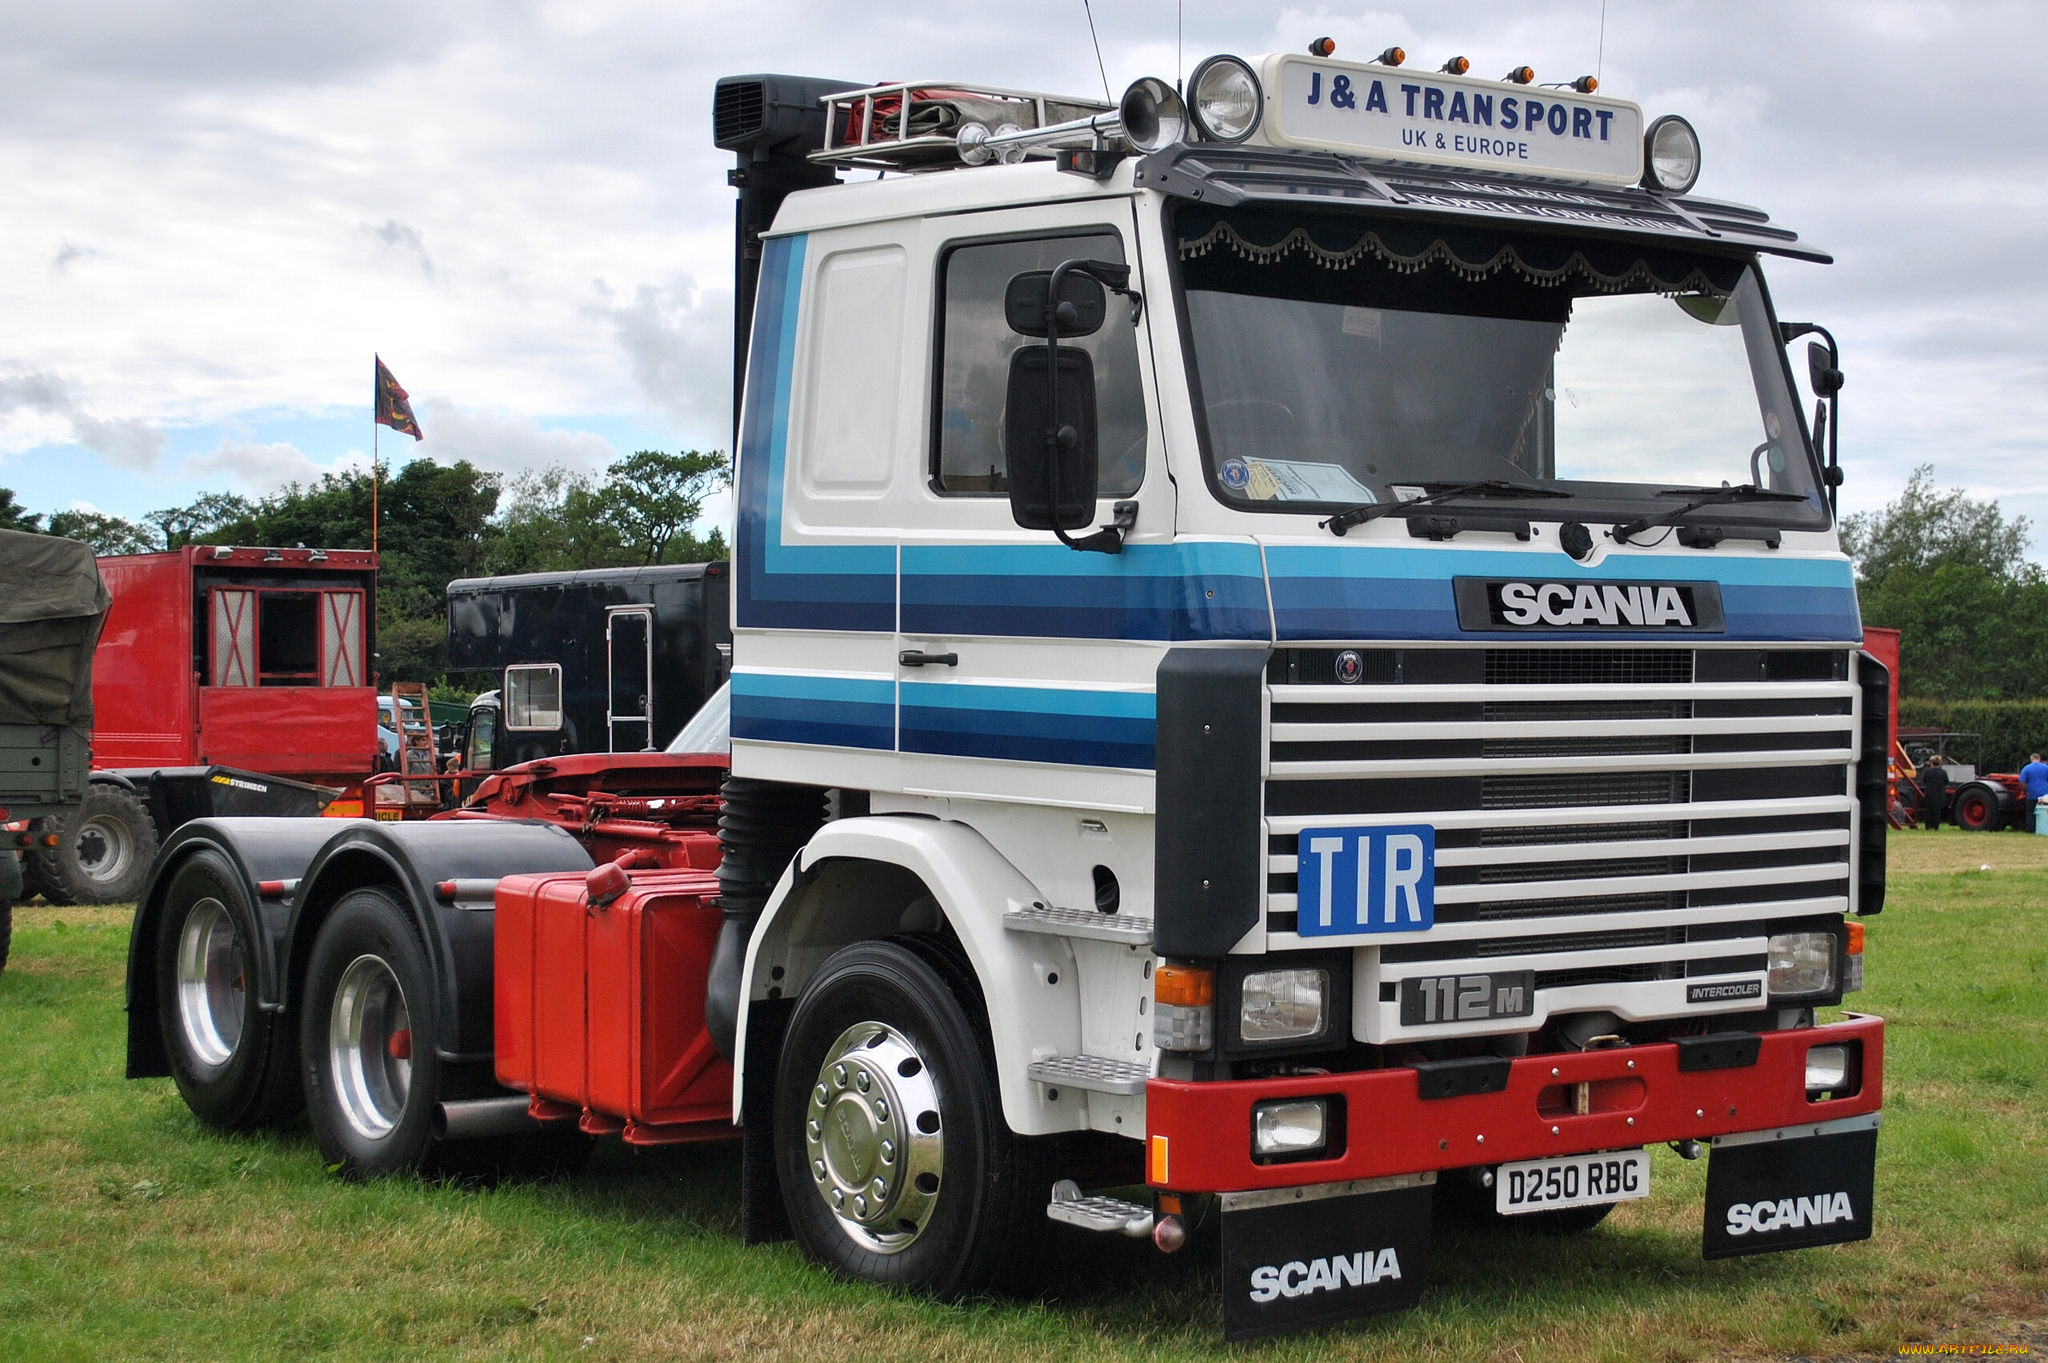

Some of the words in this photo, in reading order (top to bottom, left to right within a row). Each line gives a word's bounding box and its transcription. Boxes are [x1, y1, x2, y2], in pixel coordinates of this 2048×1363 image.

[1401, 83, 1614, 141] TRANSPORT
[1402, 128, 1427, 147] UK
[1435, 132, 1446, 150] &
[1454, 134, 1528, 159] EUROPE
[1402, 192, 1524, 214] NORTH
[1501, 582, 1692, 626] SCANIA
[1310, 833, 1424, 927] TIR
[1419, 975, 1491, 1022] 112
[1692, 984, 1760, 999] INTERCOOLER
[1508, 1165, 1579, 1205] D250
[1587, 1159, 1638, 1196] RBG
[1725, 1191, 1854, 1236] SCANIA
[1249, 1247, 1402, 1303] SCANIA
